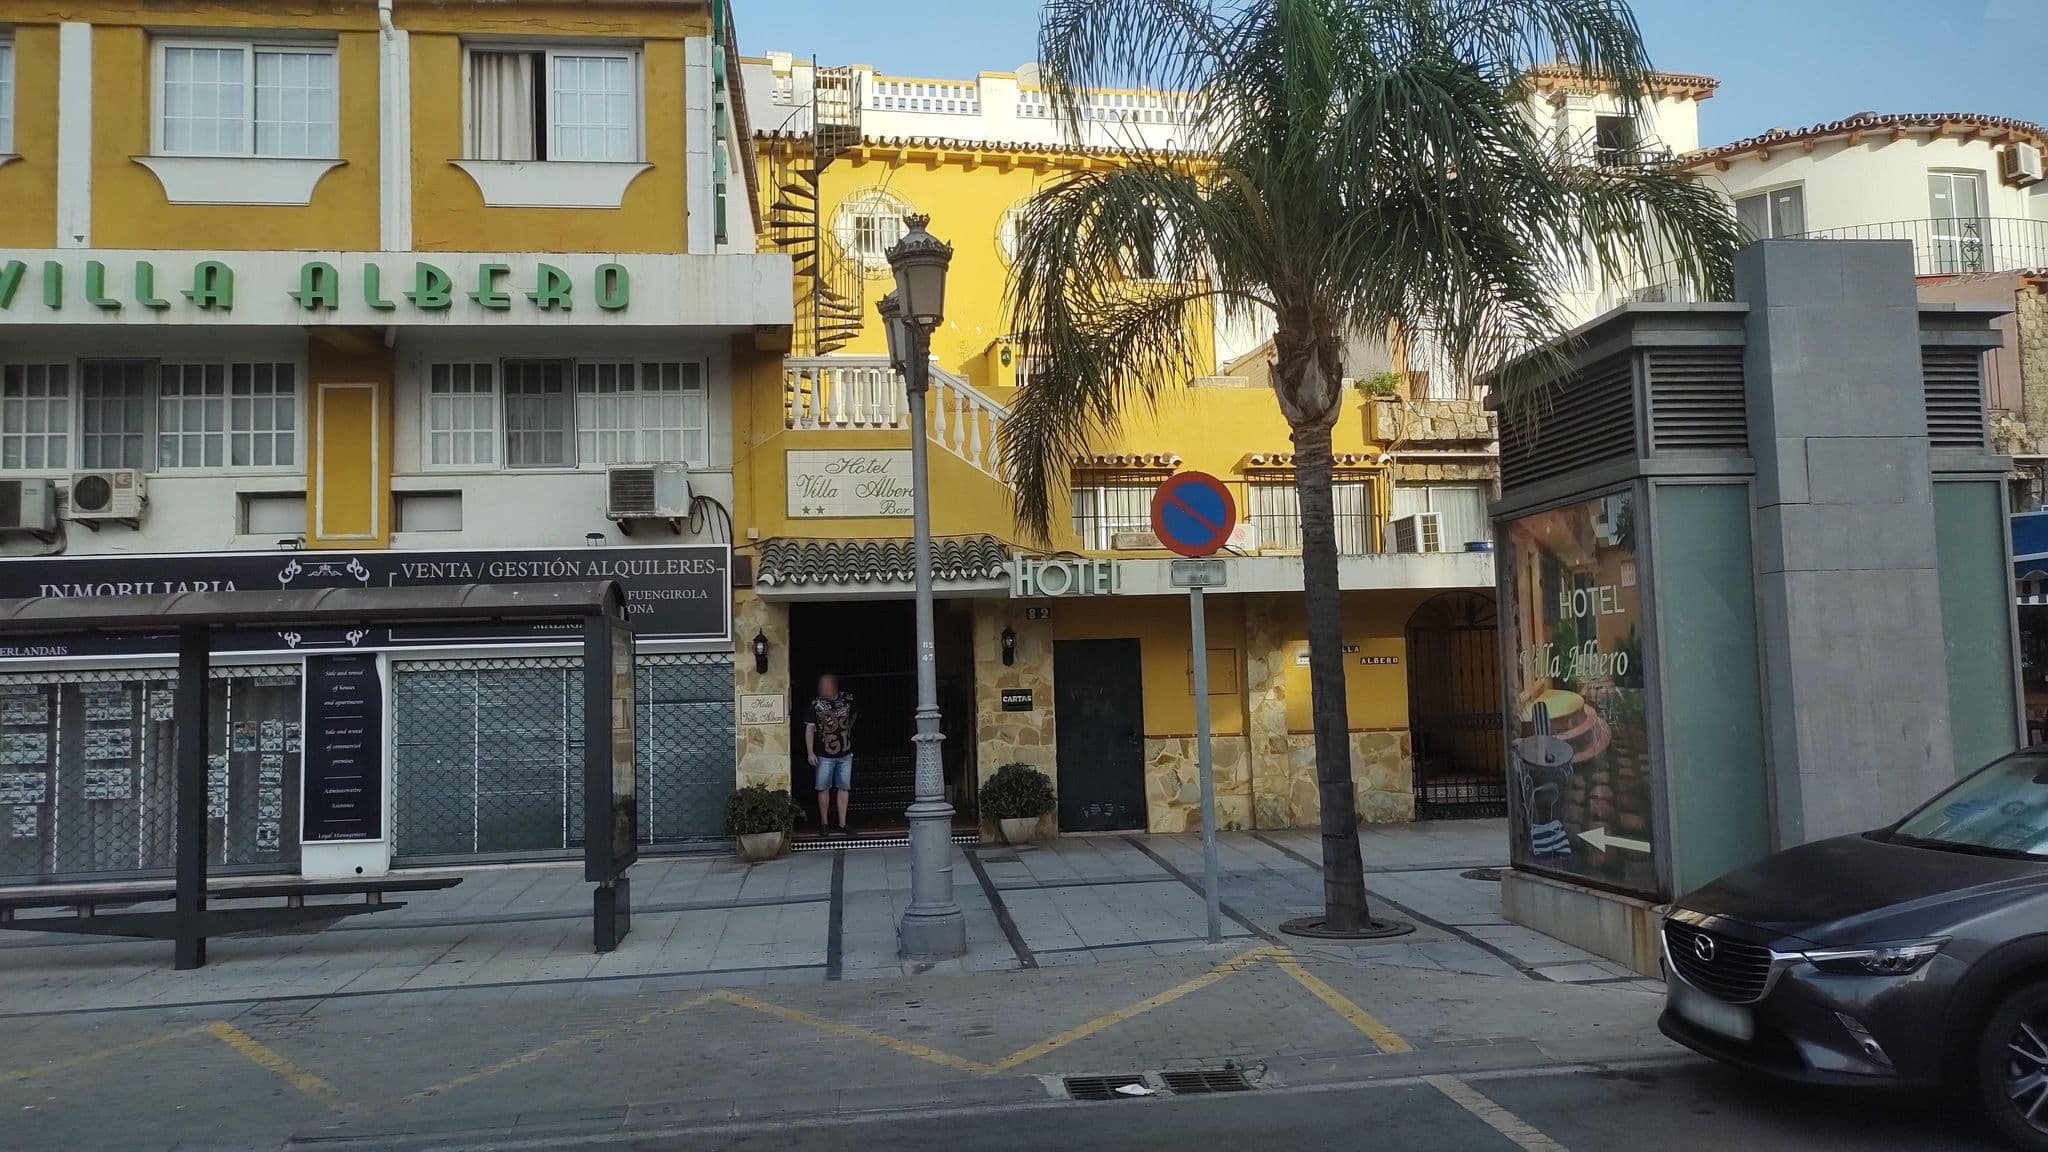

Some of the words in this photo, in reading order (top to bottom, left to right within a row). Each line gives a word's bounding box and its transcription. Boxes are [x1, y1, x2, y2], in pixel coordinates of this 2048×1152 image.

[287, 262, 630, 311] ALBERO
[825, 457, 892, 474] Hotel
[796, 474, 838, 498] Villa
[880, 500, 910, 514] Bar
[401, 562, 473, 579] VENTA
[477, 560, 485, 579] /
[489, 557, 582, 578] GESTIÓN
[586, 558, 716, 580] ALQUILERES
[1015, 555, 1122, 596] HOTEL
[627, 589, 708, 601] FUENGIROLA
[1559, 585, 1625, 619] HOTEL
[626, 603, 655, 614] ONA
[1361, 656, 1398, 665] ALBERO
[1520, 642, 1561, 678] Villa
[1563, 640, 1628, 682] Albero
[1002, 695, 1032, 703] CARTAS
